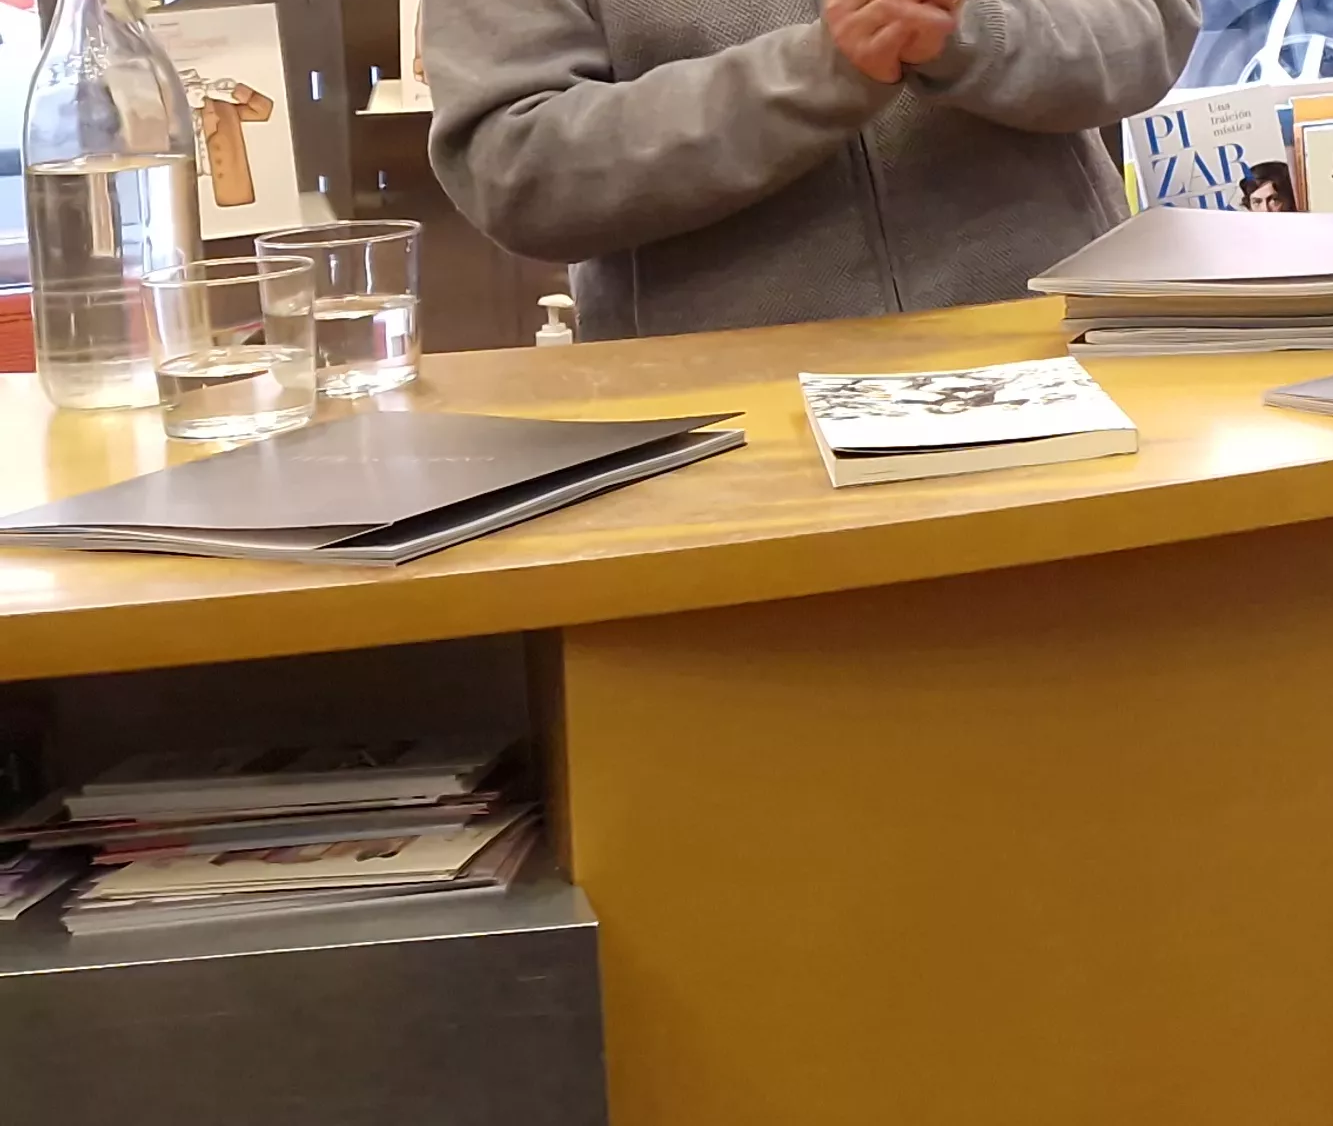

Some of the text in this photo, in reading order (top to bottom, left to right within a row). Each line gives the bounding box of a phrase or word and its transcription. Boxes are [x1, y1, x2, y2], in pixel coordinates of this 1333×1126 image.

[1208, 102, 1231, 113] Una
[1211, 110, 1252, 126] traición
[1145, 108, 1194, 156] PI
[1213, 122, 1252, 137] mística
[1152, 143, 1252, 199] ZAR
